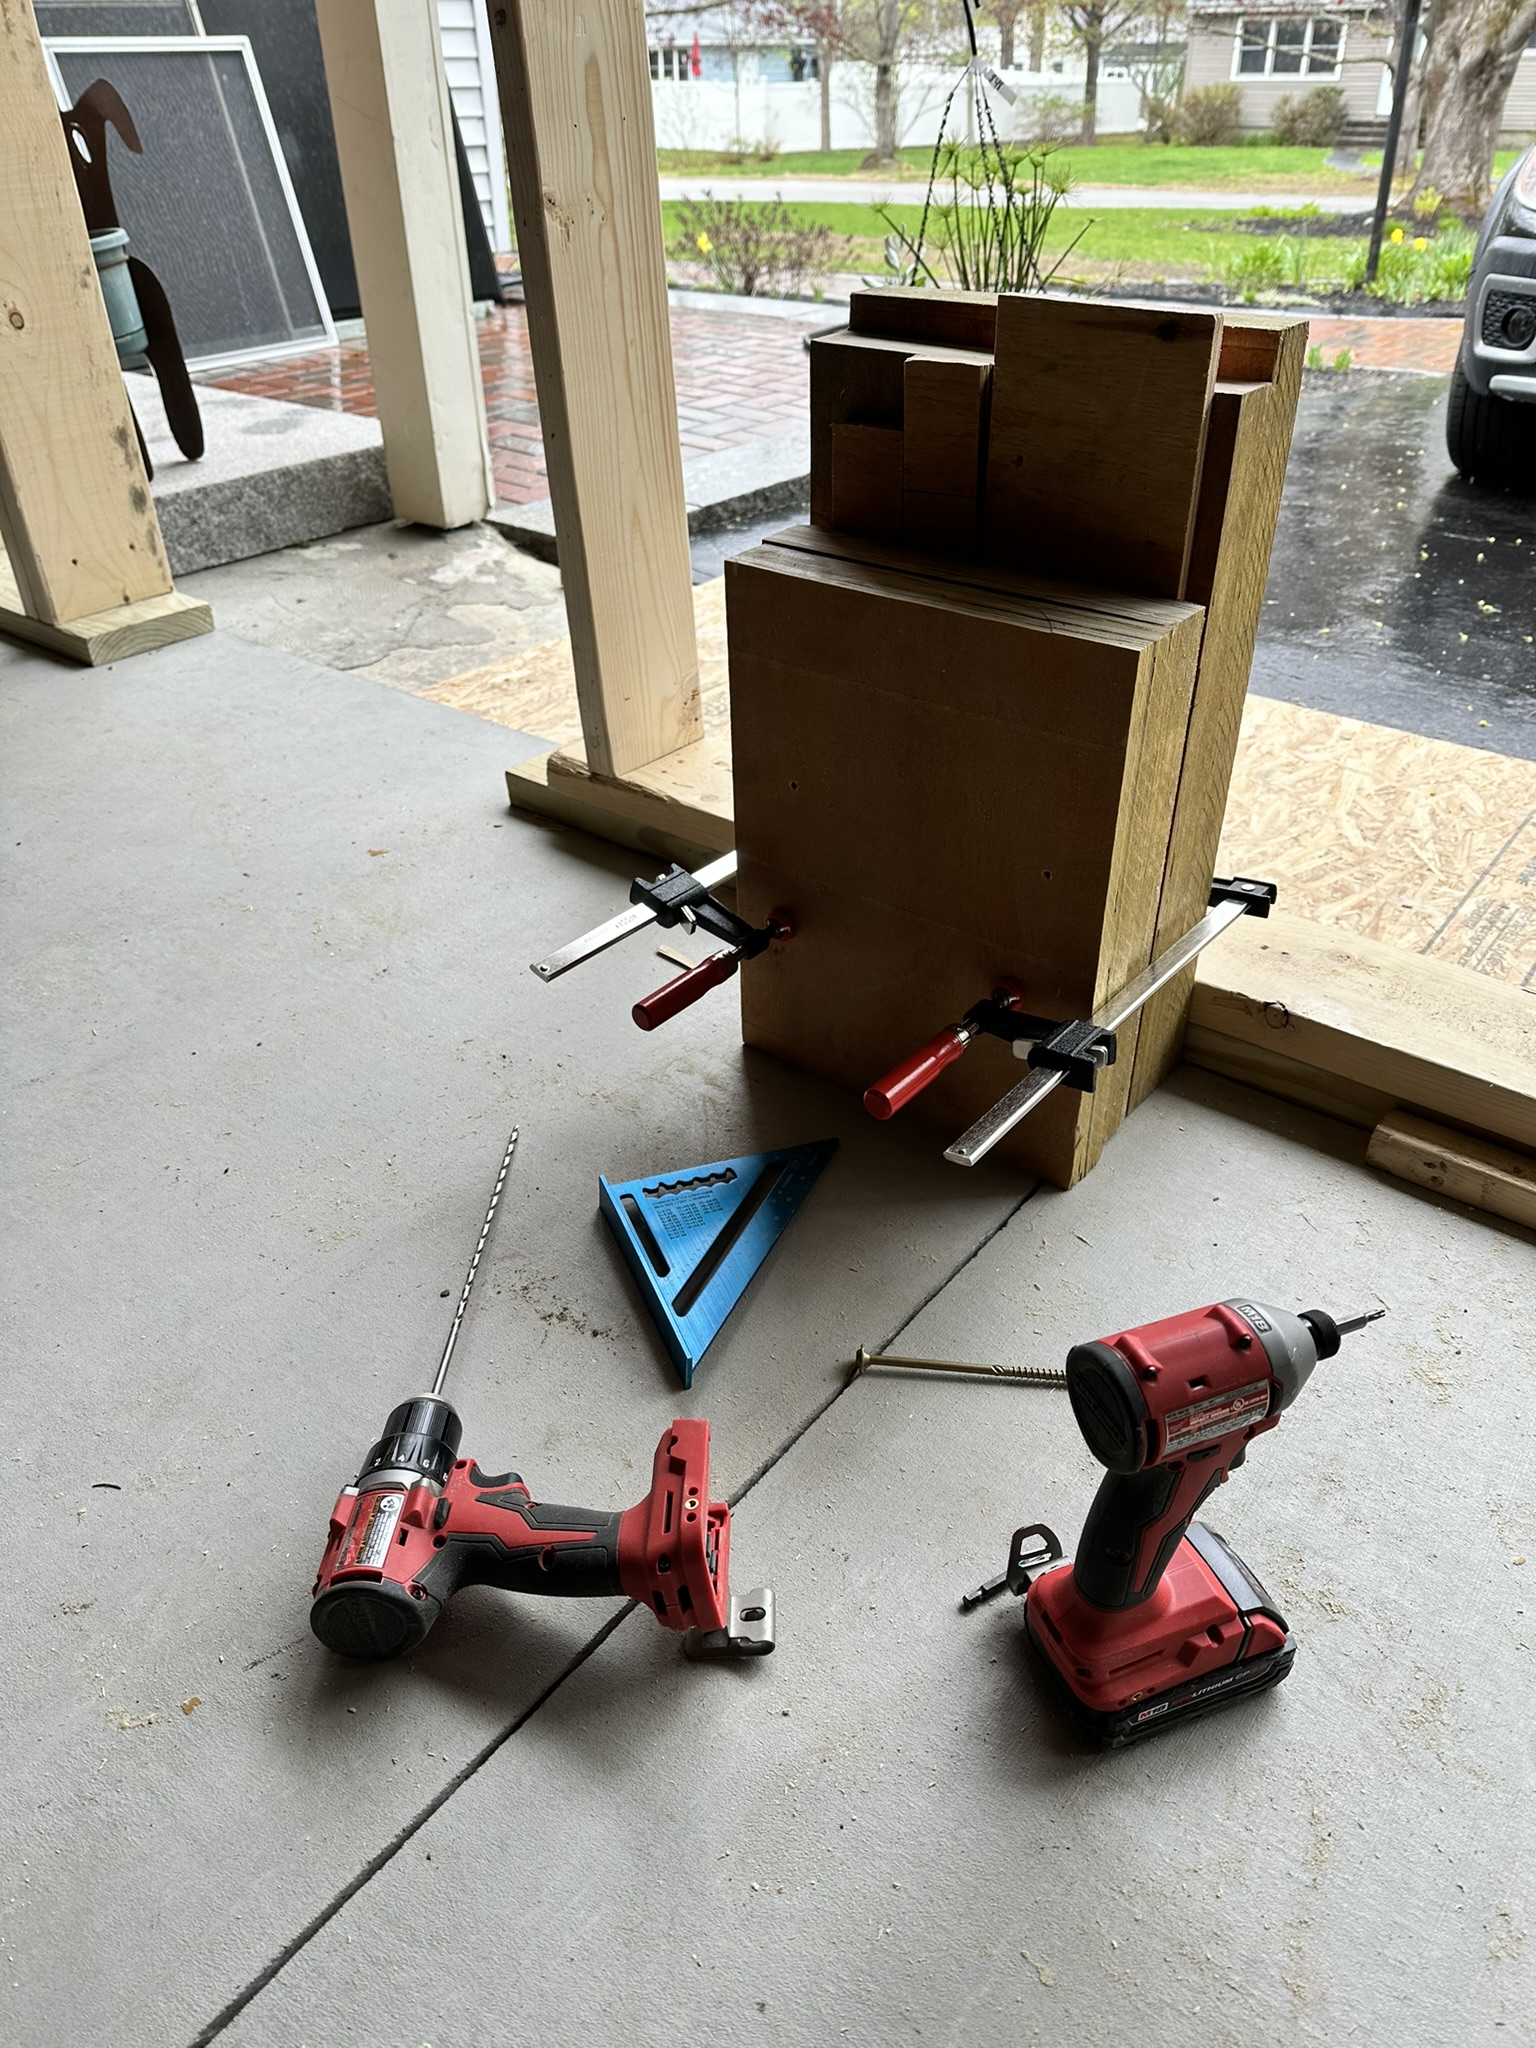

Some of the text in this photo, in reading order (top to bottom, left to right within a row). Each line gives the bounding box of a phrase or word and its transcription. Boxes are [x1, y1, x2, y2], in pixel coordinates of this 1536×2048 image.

[1239, 1305, 1270, 1332] M18
[397, 1454, 405, 1463] 4
[1138, 1702, 1168, 1721] M18
